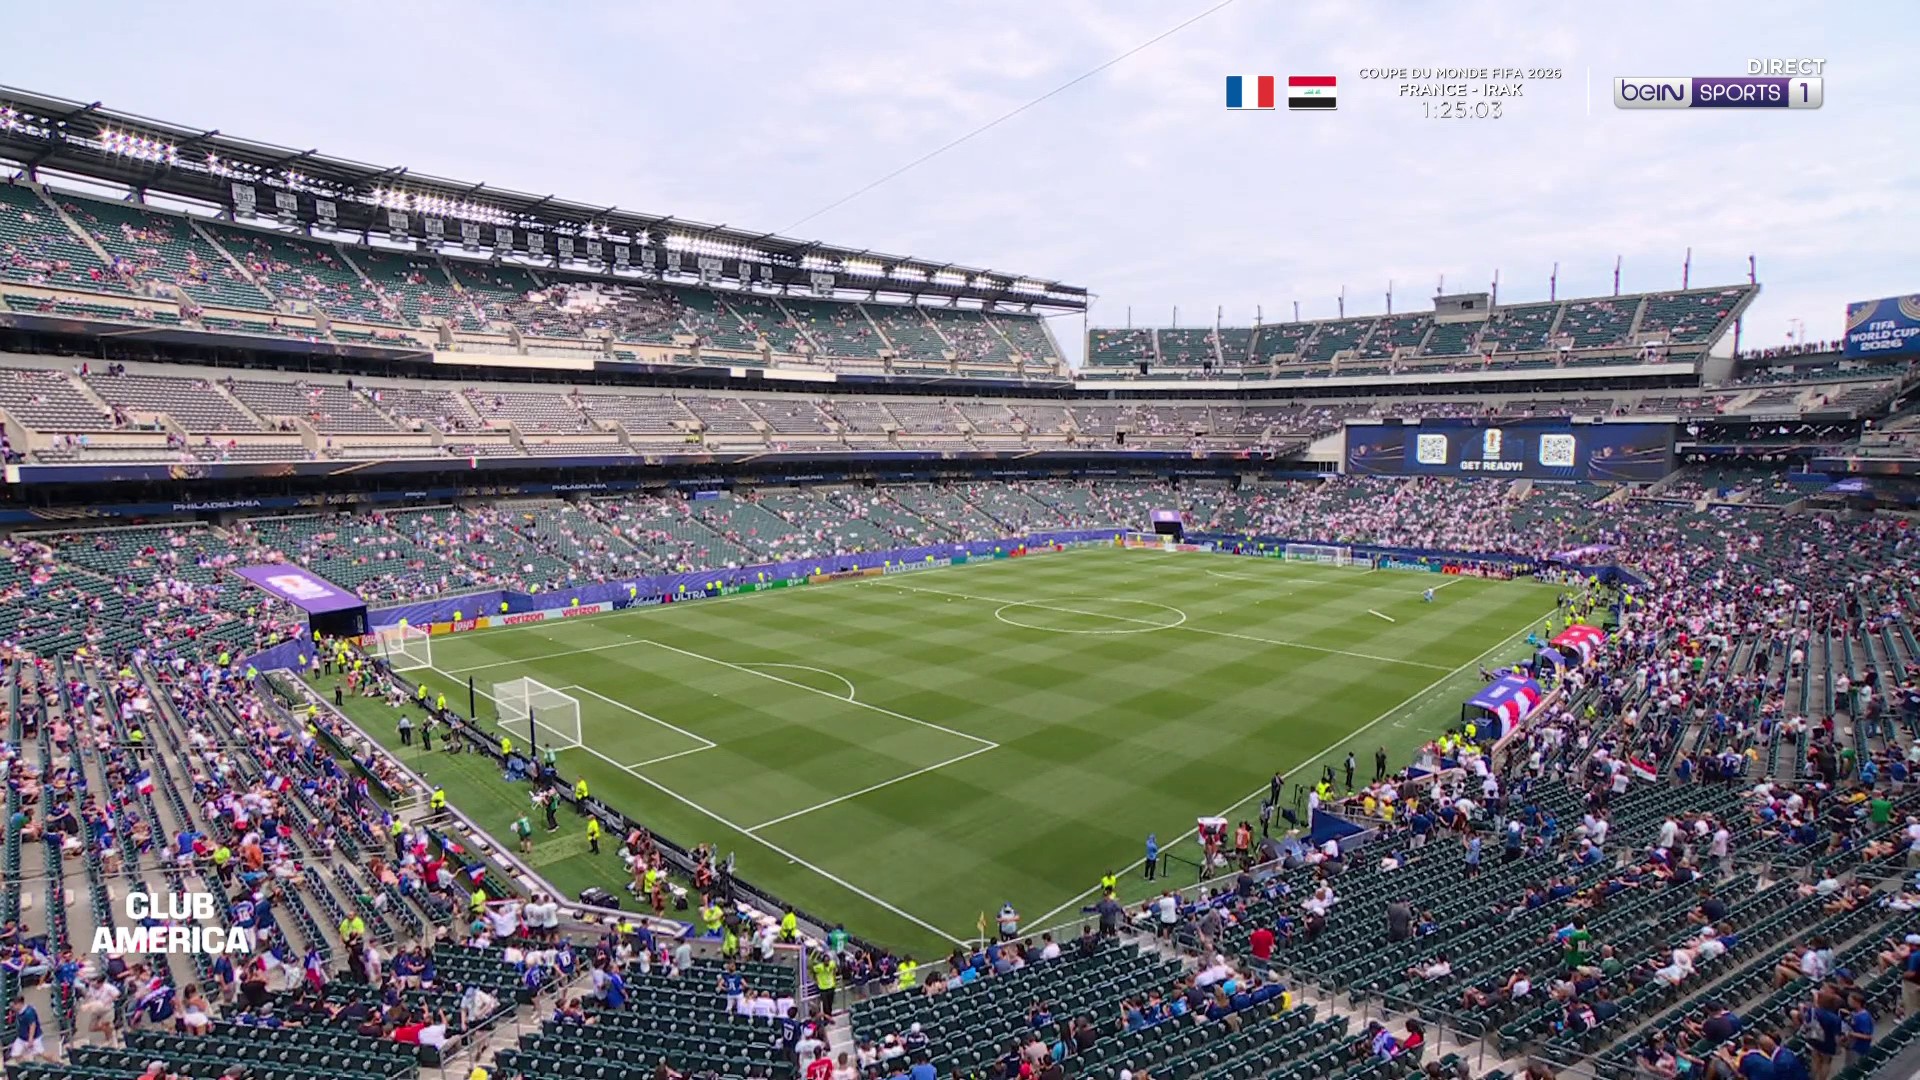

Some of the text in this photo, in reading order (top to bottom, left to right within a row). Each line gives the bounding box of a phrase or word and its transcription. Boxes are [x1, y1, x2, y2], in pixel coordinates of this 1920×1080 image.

[1869, 320, 1896, 331] FIFA
[1850, 327, 1920, 343] WORLD CUP
[1860, 339, 1903, 351] 2026
[1460, 461, 1523, 471] GET READY!
[173, 500, 261, 511] PHILADELPHIA
[1387, 560, 1431, 572] Hisense
[672, 589, 707, 602] ULTRA
[561, 604, 601, 618] verizon
[503, 612, 545, 625] verizon
